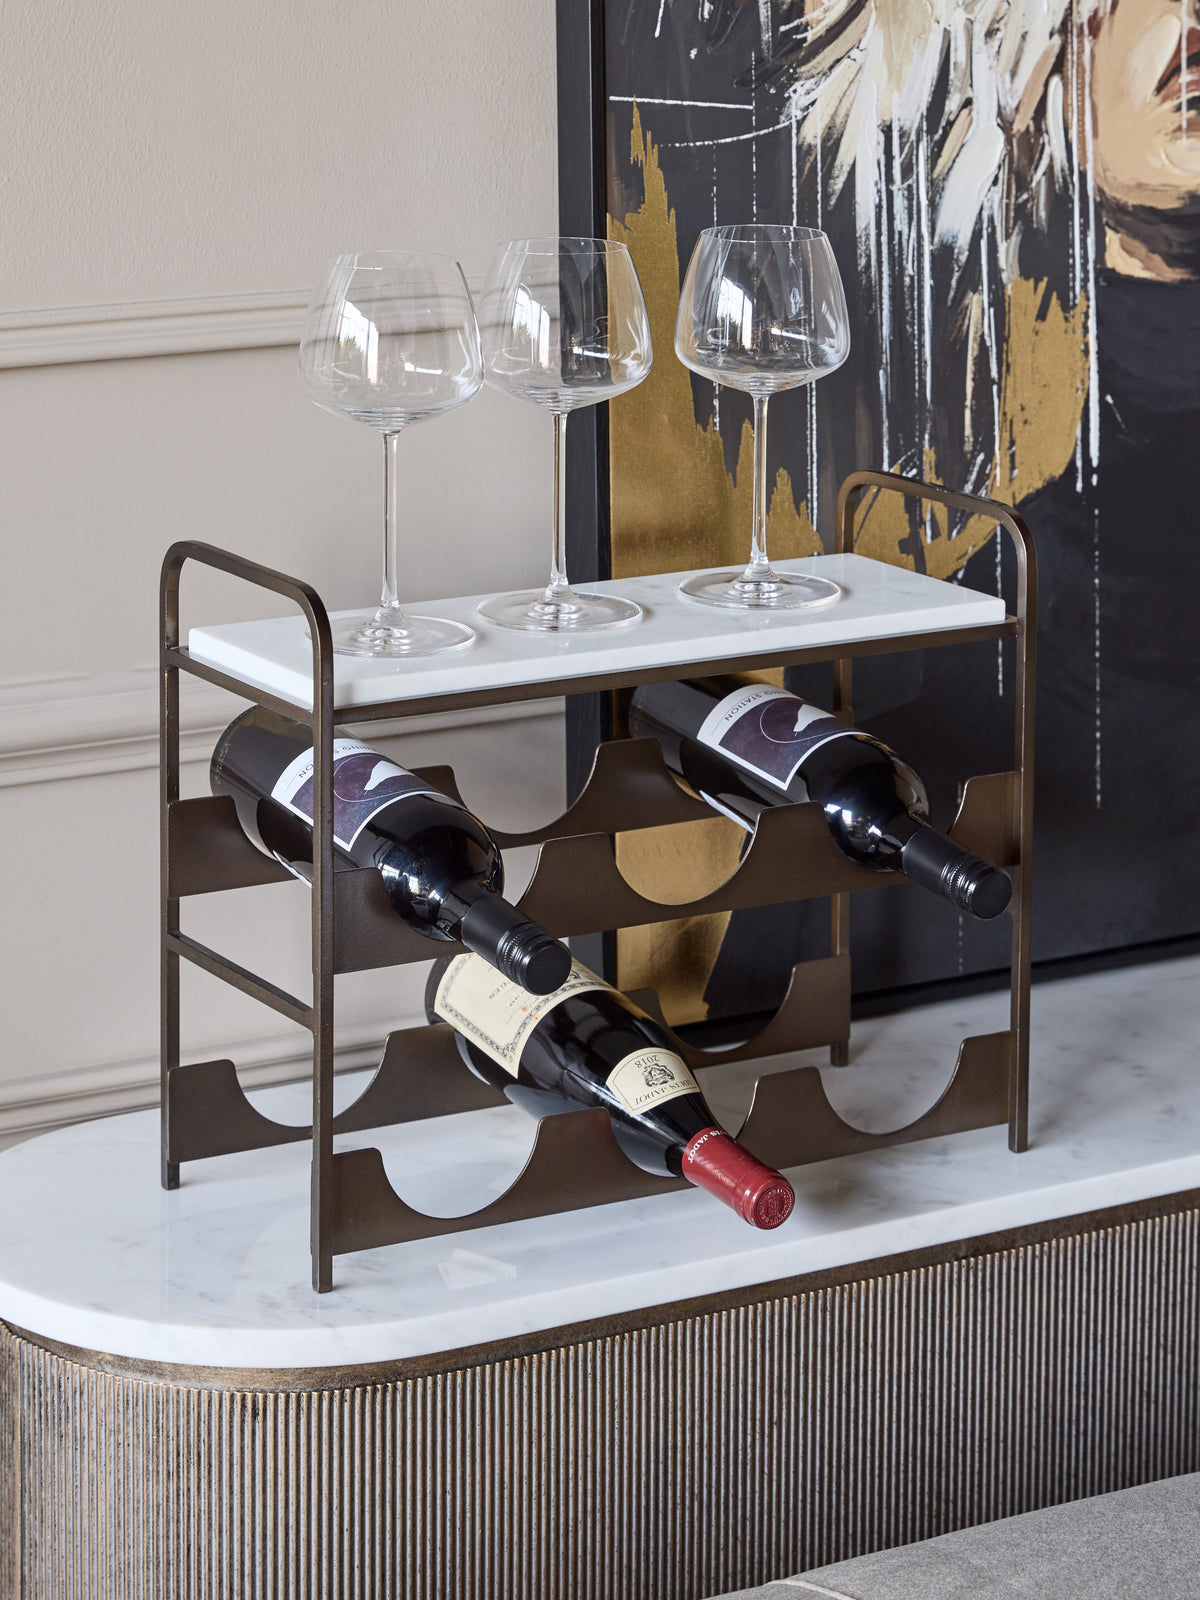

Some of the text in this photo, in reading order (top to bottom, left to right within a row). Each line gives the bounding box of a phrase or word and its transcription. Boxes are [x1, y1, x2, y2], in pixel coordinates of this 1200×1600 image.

[725, 694, 762, 722] STATION
[634, 1055, 661, 1069] 2018
[634, 1087, 667, 1106] JADOT
[687, 1134, 709, 1164] JADOT
